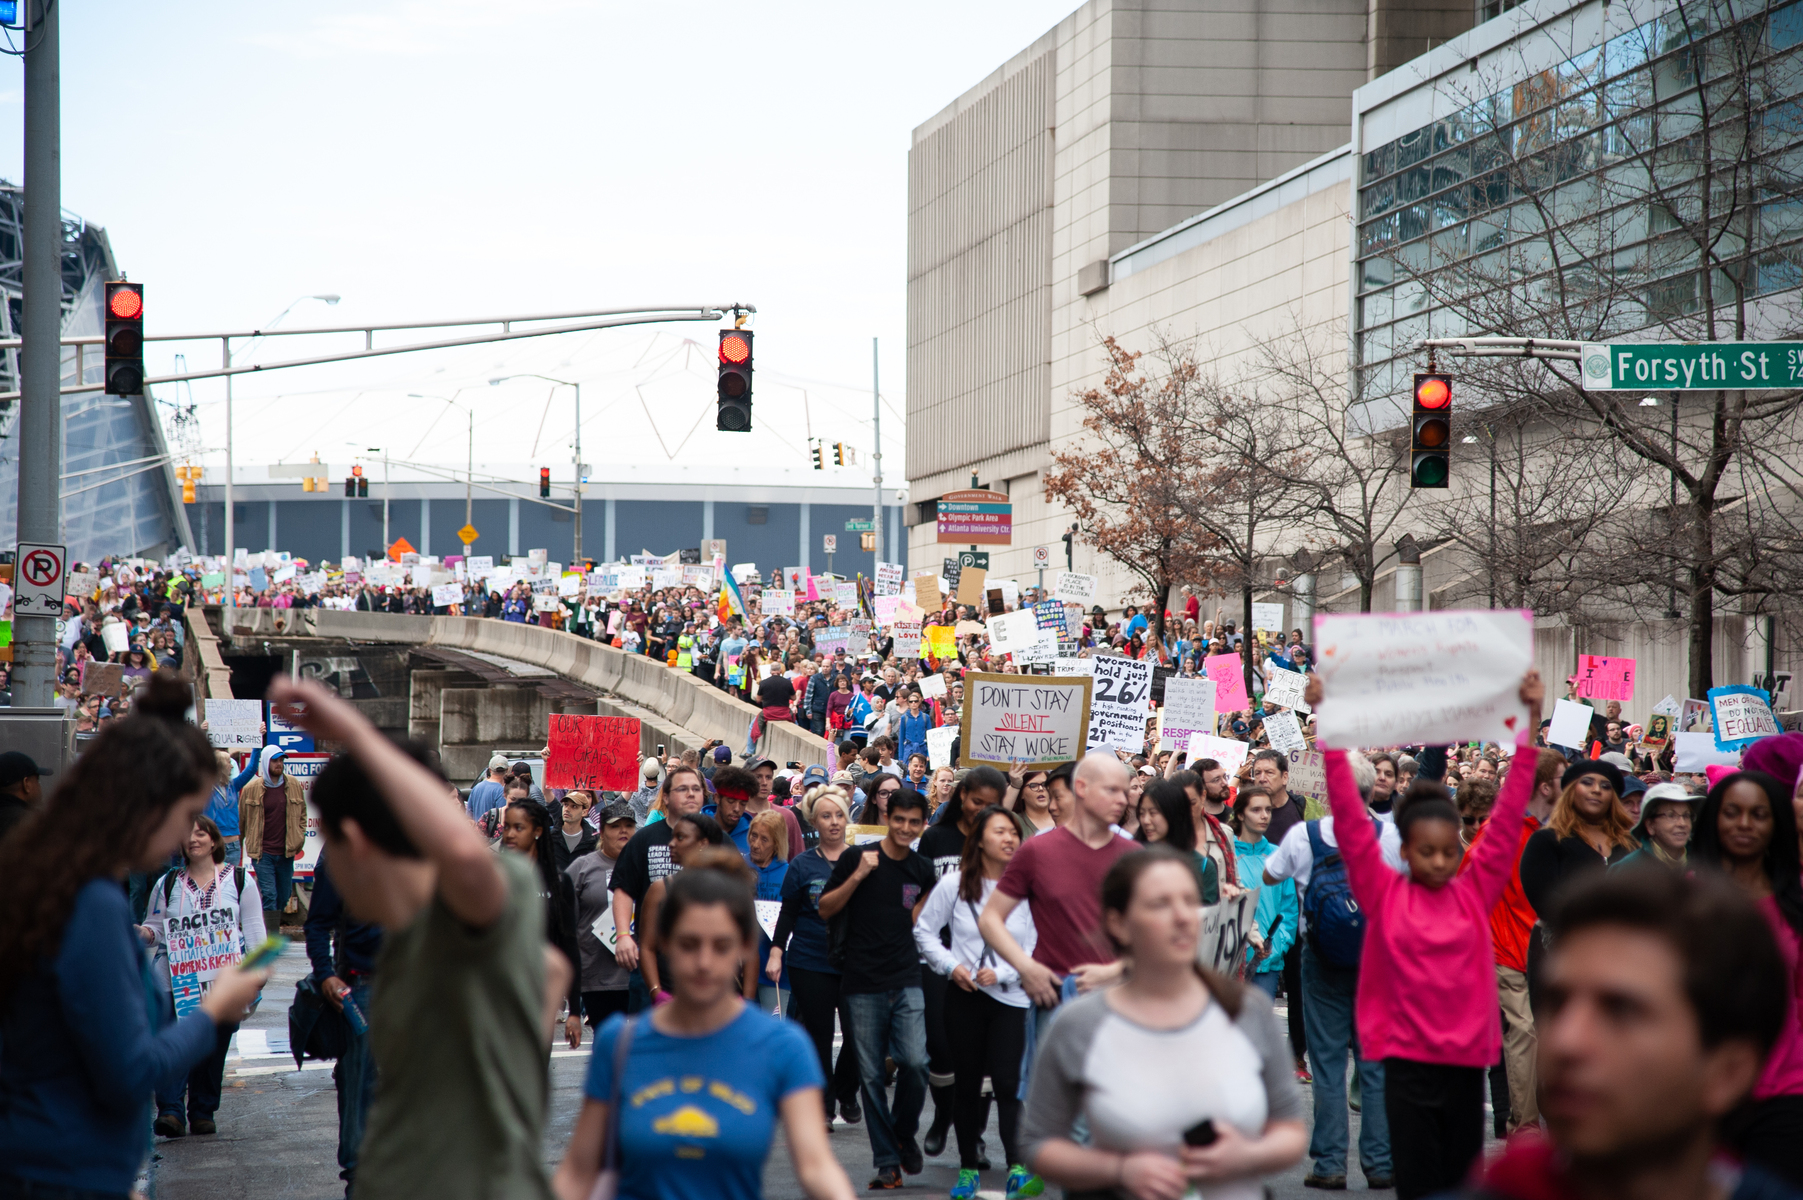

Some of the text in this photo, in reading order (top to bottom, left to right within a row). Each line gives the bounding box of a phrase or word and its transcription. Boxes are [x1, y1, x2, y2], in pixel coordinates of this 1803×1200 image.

[1619, 352, 1726, 388] Forsyth
[1741, 352, 1769, 380] St
[948, 514, 971, 523] Olympic
[972, 514, 985, 522] Park
[948, 525, 969, 533] Atlanta
[971, 525, 999, 535] University
[1059, 588, 1090, 598] REVOLUTION
[816, 632, 840, 640] HEALTH
[1094, 664, 1149, 682] hold just
[1171, 679, 1189, 687] When
[1095, 678, 1148, 705] 26%
[981, 686, 1074, 713] DON'T STAY
[1719, 699, 1739, 708] MEN
[1102, 703, 1114, 711] high
[1117, 706, 1137, 715] ranking
[1183, 710, 1196, 718] thing
[1729, 709, 1741, 718] DO
[1001, 713, 1050, 732] SILENT
[1091, 710, 1144, 723] government
[1165, 717, 1177, 725] your
[558, 715, 639, 736] OUR RIGHTS
[207, 733, 262, 745] EQUAL RIGHTS
[593, 736, 604, 746] UP
[981, 734, 1016, 756] STAY
[1025, 737, 1070, 756] WOKE
[1174, 740, 1189, 750] HE
[574, 746, 620, 766] GRABS
[1290, 750, 1327, 769] GIR
[553, 762, 573, 775] AND
[614, 768, 633, 780] ARE
[649, 845, 667, 853] SPEAK
[168, 907, 234, 933] RACISM
[170, 929, 233, 952] EQUALITY
[168, 941, 237, 963] CLIMATE CHANGE
[170, 952, 243, 977] WOMENS RIGHTS
